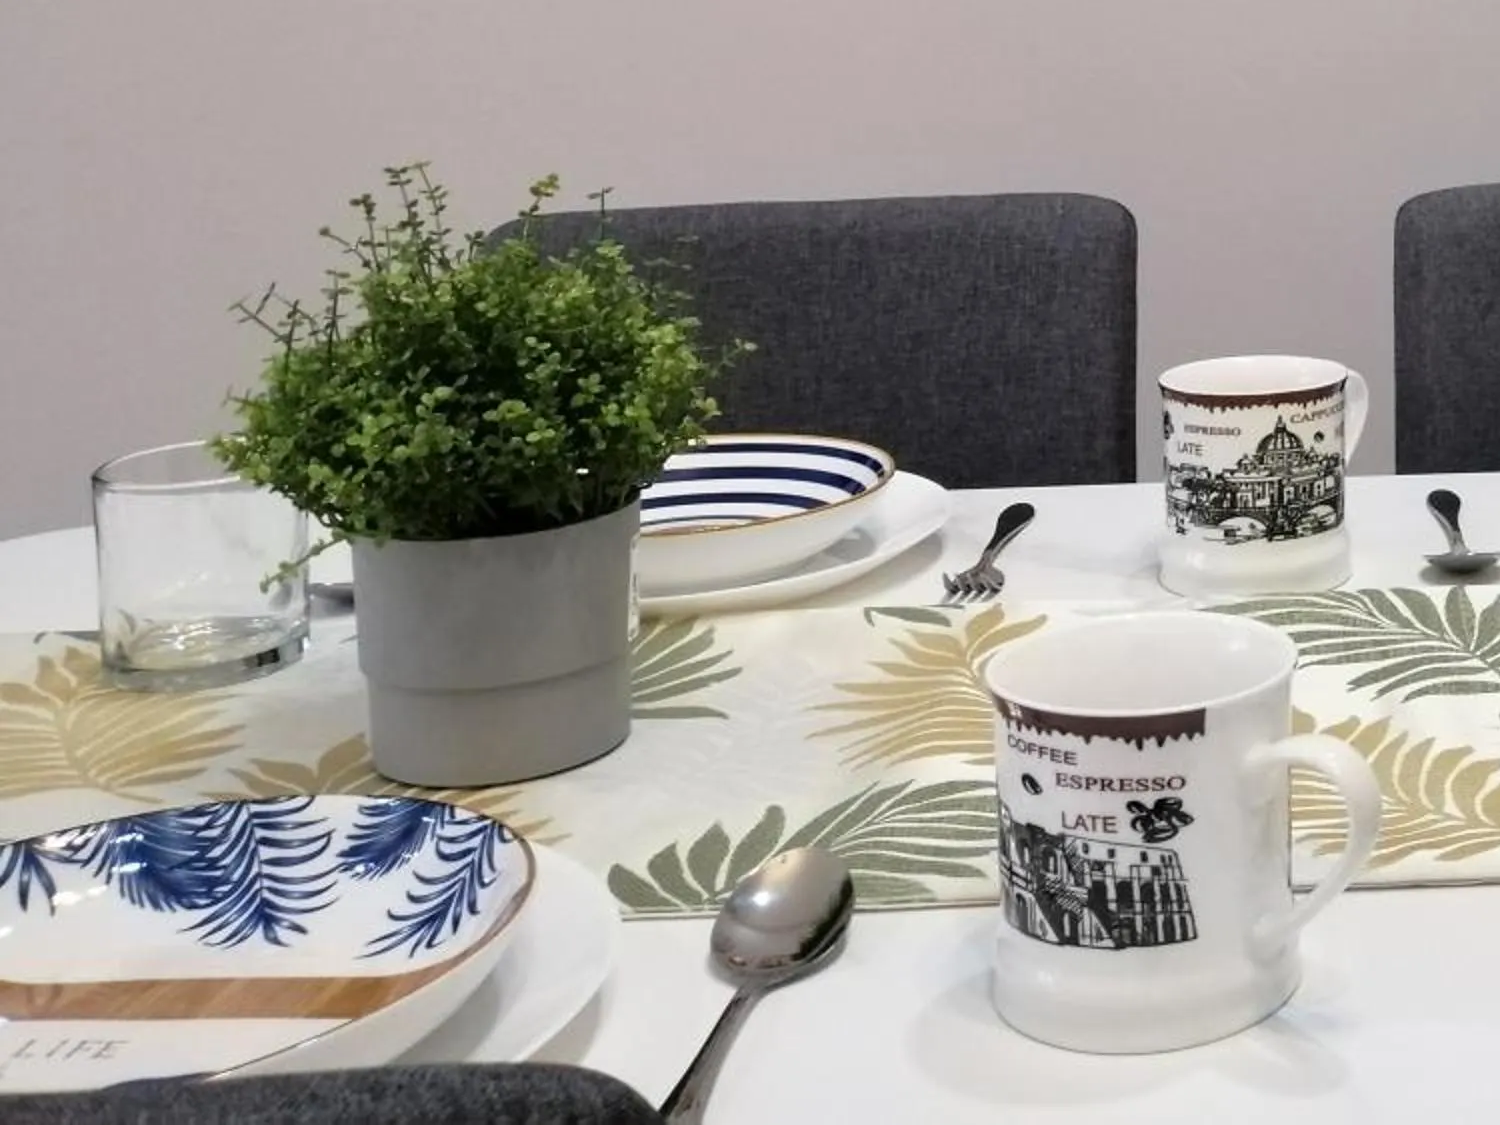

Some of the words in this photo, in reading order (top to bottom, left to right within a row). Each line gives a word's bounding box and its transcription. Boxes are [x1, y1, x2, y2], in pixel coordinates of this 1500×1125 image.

[1178, 442, 1204, 458] LATE
[1008, 734, 1078, 766] COFFEE
[1056, 772, 1187, 793] ESPRESSO
[1062, 810, 1119, 834] LATE
[13, 1038, 130, 1060] LIFE
